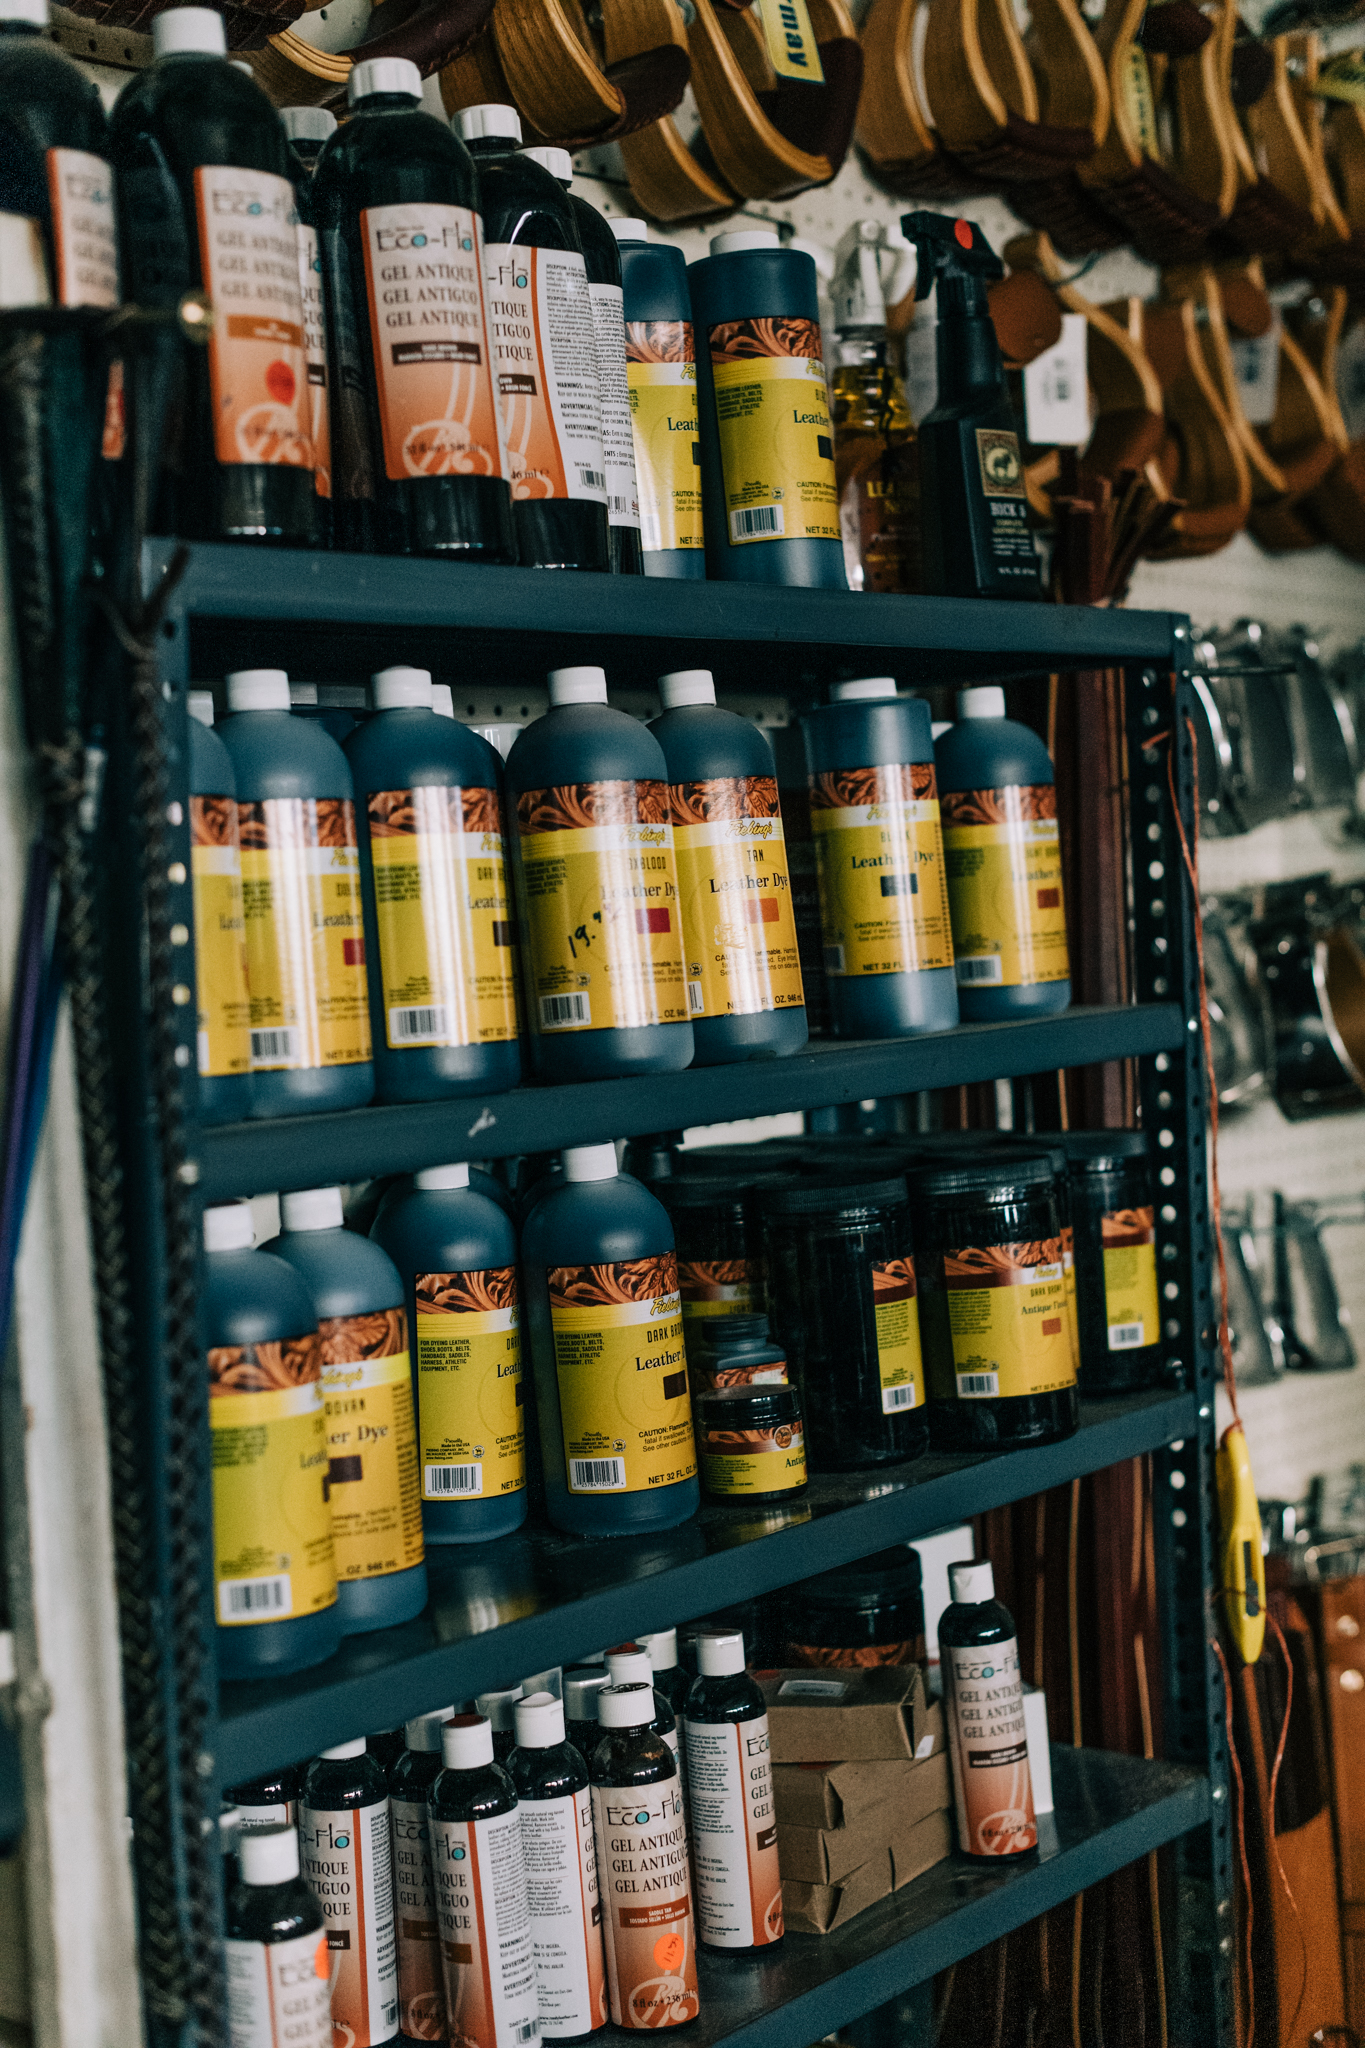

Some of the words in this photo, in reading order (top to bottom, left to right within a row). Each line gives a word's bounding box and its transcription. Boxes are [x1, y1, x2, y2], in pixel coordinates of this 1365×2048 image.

[778, 0, 808, 67] may
[381, 265, 412, 282] GEL
[415, 263, 475, 283] ANTIQUE
[383, 288, 412, 305] GEL
[417, 286, 478, 306] ANTIGUO
[385, 311, 414, 328] GEL
[420, 309, 480, 330] ANTIQUE
[805, 526, 820, 534] NET
[680, 536, 693, 545] NET
[747, 849, 765, 863] TAN
[914, 850, 935, 865] Dye
[709, 873, 770, 894] Leather
[772, 872, 788, 891] Dye
[862, 962, 880, 971] NET
[881, 961, 892, 970] 32
[774, 994, 787, 1004] OZ.
[1021, 1303, 1053, 1316] Antique
[647, 1328, 669, 1344] DARK
[635, 1350, 681, 1373] Leather
[358, 1424, 389, 1444] Dye
[638, 1426, 669, 1439] CAUTION:
[643, 1445, 655, 1453] See
[656, 1442, 670, 1450] other
[644, 1437, 657, 1445] fatal
[648, 1475, 665, 1485] NET
[667, 1472, 675, 1481] 32
[676, 1469, 686, 1479] FL.
[501, 1480, 513, 1491] NET
[959, 1690, 983, 1703] GEL
[961, 1708, 984, 1721] GEL
[963, 1726, 986, 1740] GEL
[750, 1764, 767, 1781] GEL
[751, 1784, 769, 1800] GEL
[753, 1802, 771, 1819] GEL
[611, 1838, 636, 1853] GEL
[398, 1850, 418, 1867] GEL
[613, 1858, 637, 1874] GEL
[399, 1870, 418, 1887] GEL
[615, 1879, 640, 1894] GEL
[401, 1890, 421, 1907] GEL
[664, 1907, 672, 1915] TAN
[632, 1999, 639, 2009] 8
[639, 1998, 647, 2009] fl
[648, 1999, 659, 2008] oz
